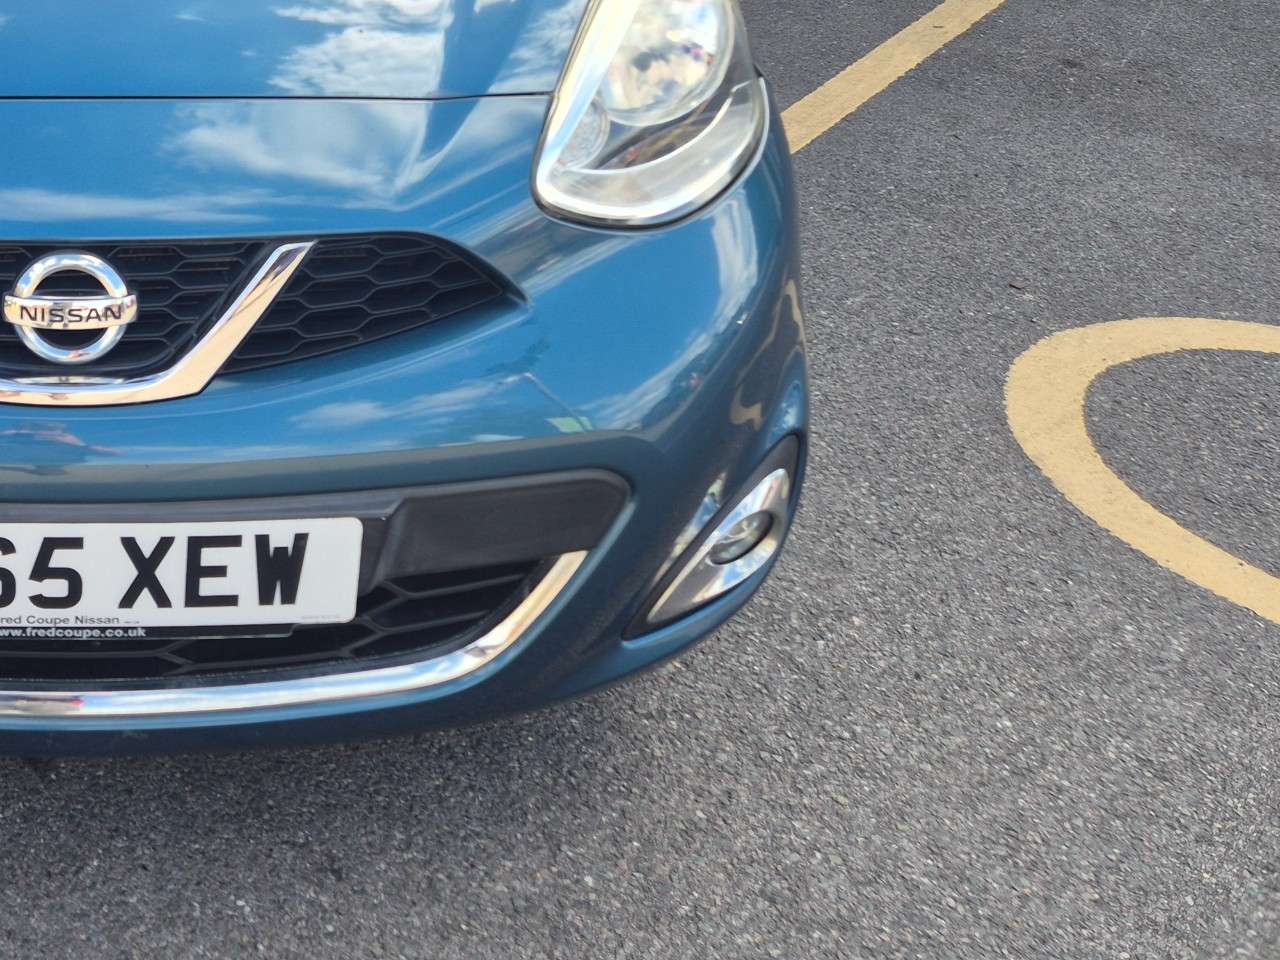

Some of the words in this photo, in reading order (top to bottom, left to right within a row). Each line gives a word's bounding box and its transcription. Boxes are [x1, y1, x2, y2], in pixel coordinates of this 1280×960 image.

[20, 304, 122, 323] NISSAN
[118, 532, 310, 609] XEW
[26, 615, 70, 627] Coupe
[74, 615, 120, 625] Nissan
